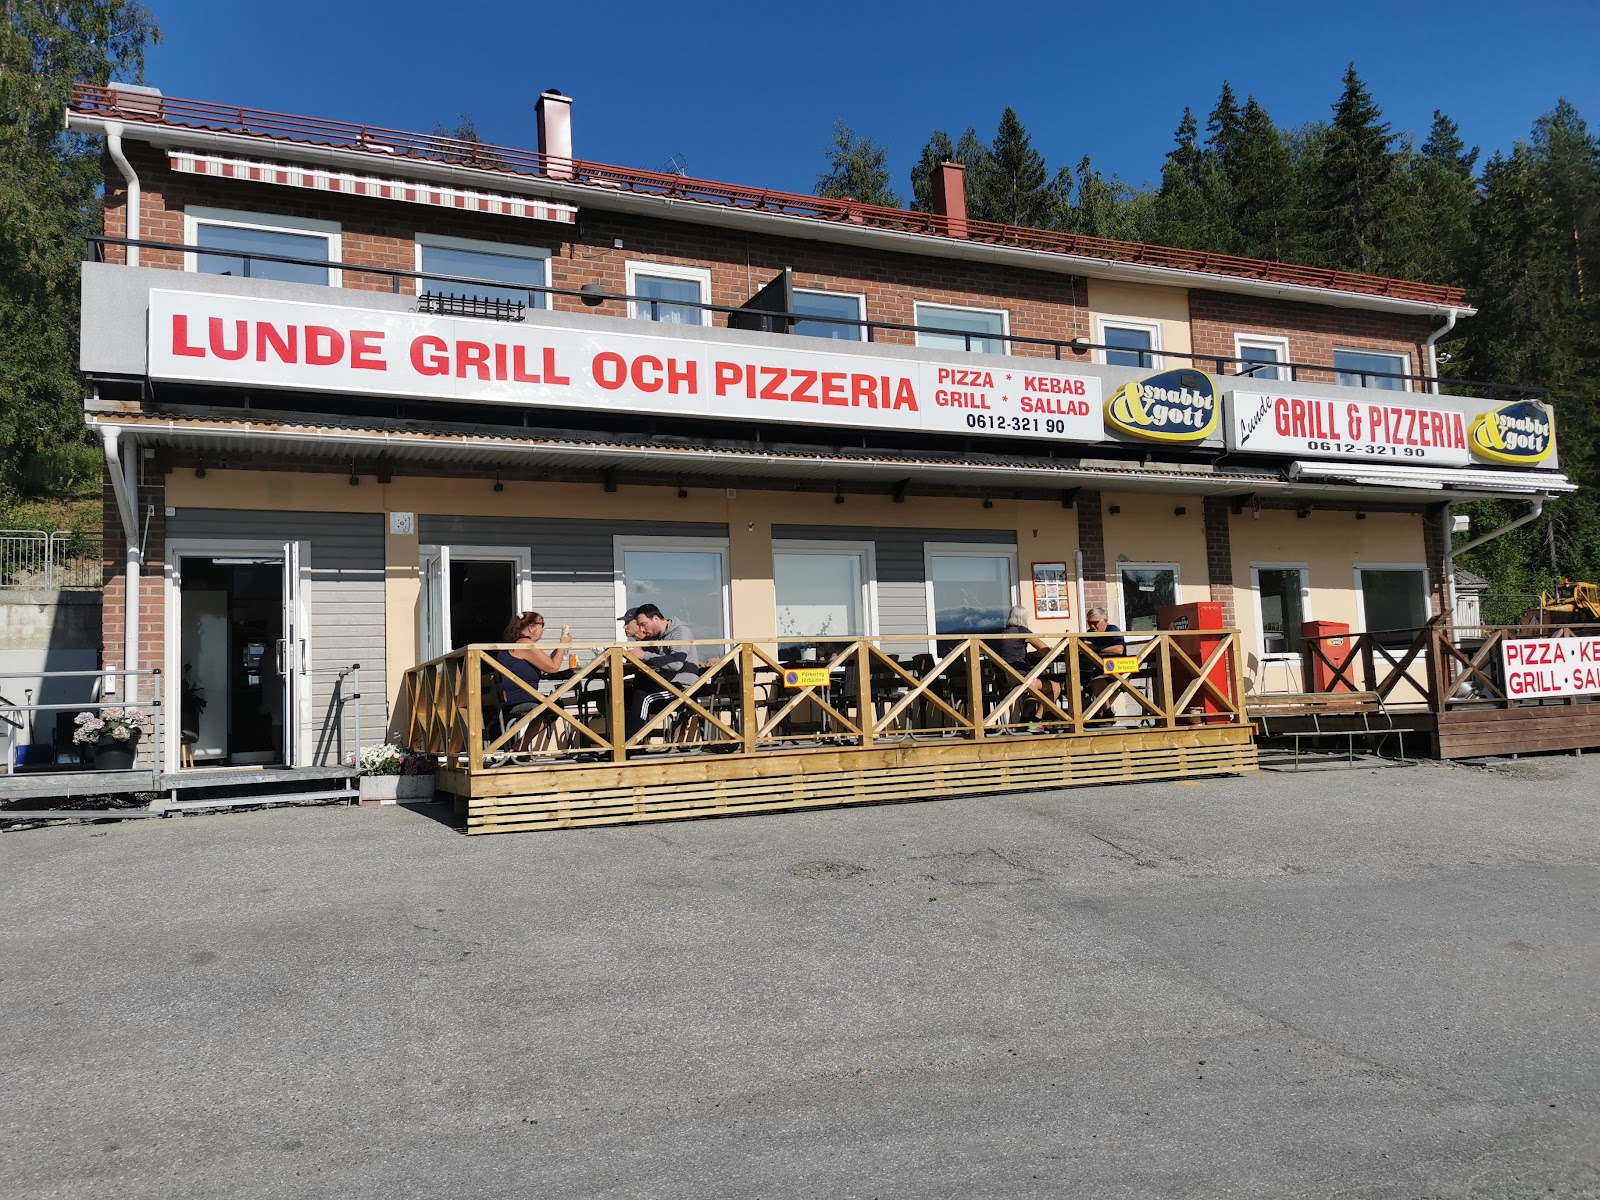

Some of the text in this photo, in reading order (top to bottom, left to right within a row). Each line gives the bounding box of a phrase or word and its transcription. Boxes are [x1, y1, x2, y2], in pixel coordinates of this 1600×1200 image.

[171, 314, 919, 412] LUNDE GRILL OCH PIZZERIA
[937, 367, 1086, 396] PIZZA KEBAB
[934, 389, 1090, 417] GRILL SALLAD
[1143, 384, 1213, 410] snabbt
[966, 413, 1065, 433] 0612-321 90
[1152, 404, 1204, 428] gott
[1240, 395, 1273, 447] Lunde
[1274, 397, 1466, 450] GRILL & PIZZERIA
[1499, 414, 1549, 437] snabbt
[1307, 440, 1426, 458] 0612-321 90
[1505, 431, 1544, 453] gott
[1506, 642, 1566, 666] PIZZA
[1509, 670, 1562, 694] GRILL
